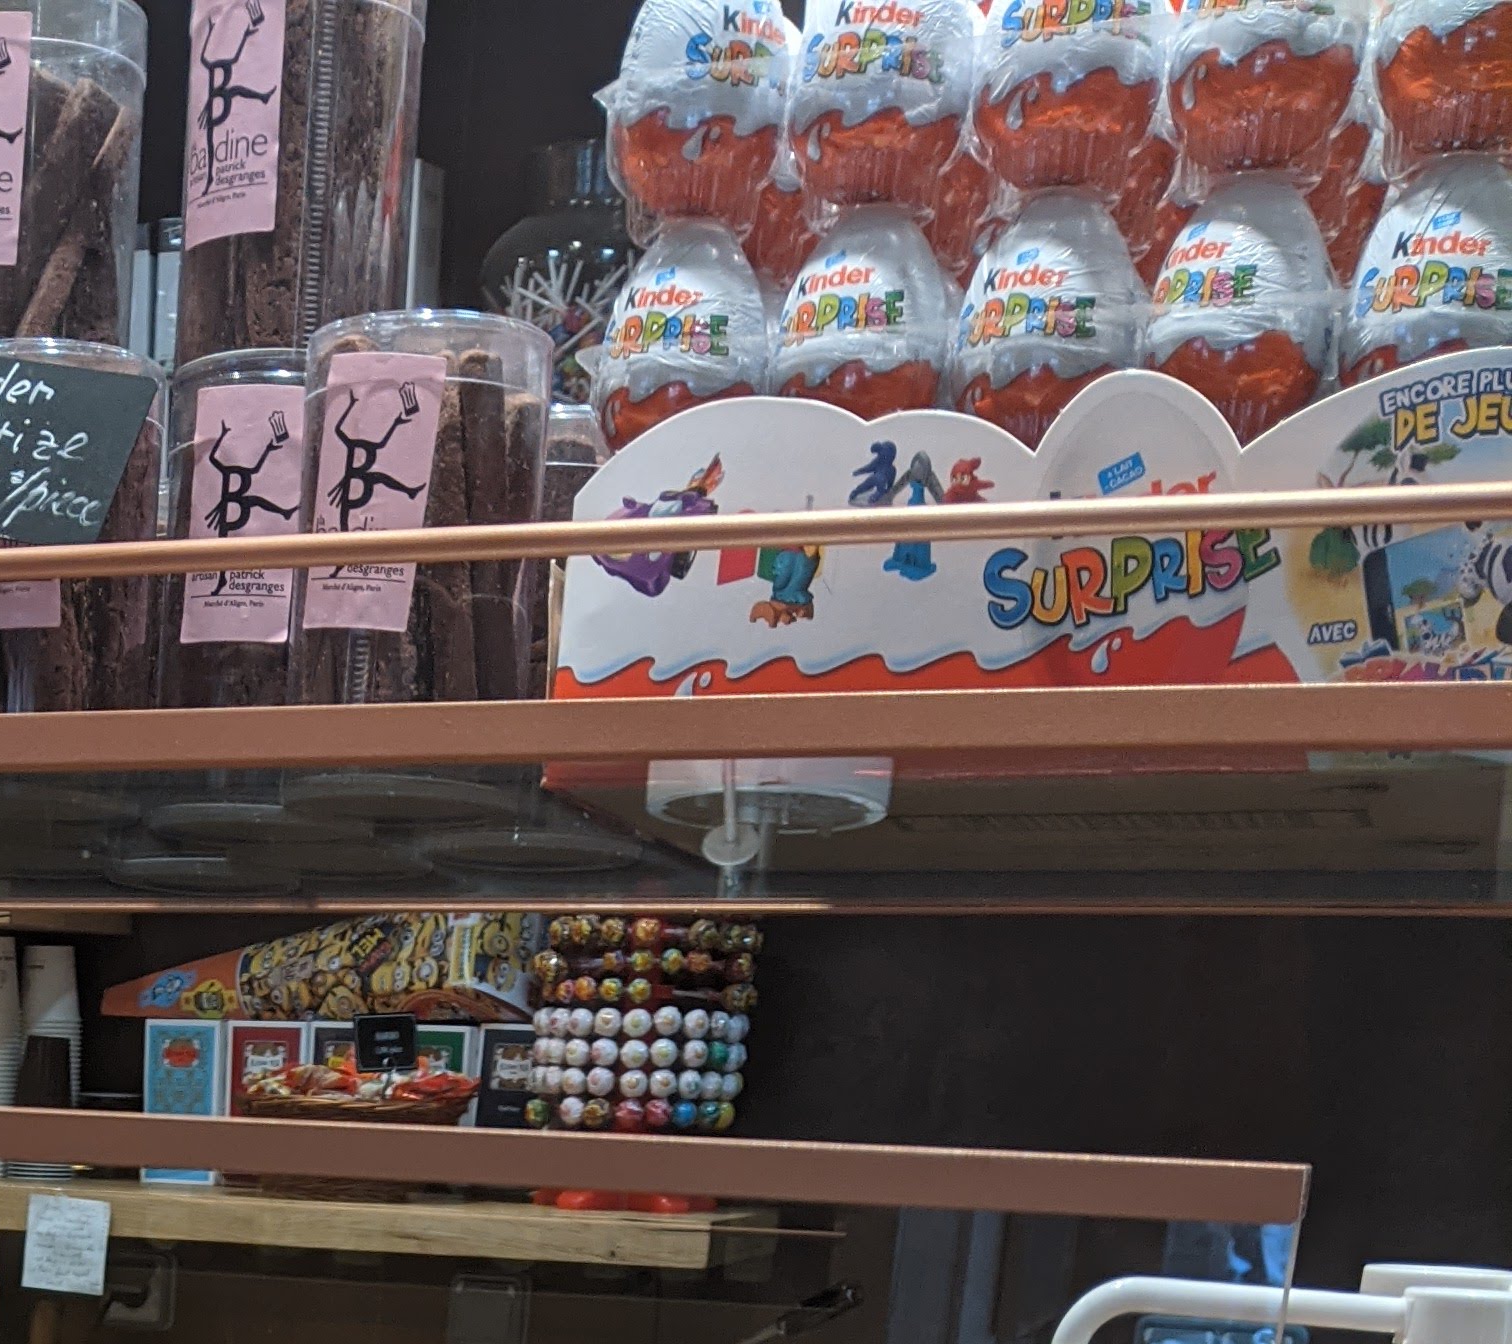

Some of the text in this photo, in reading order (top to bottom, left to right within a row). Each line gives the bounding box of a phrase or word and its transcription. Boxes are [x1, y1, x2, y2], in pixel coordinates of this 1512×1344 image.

[835, 2, 925, 27] Kinder
[1163, 238, 1231, 269] inder
[1392, 231, 1492, 261] Kinder
[798, 264, 876, 297] Kinder
[984, 264, 1069, 293] Kinder
[1152, 264, 1257, 317] RPRISE
[1355, 261, 1512, 318] SURPRISE
[625, 286, 703, 310] Kinder
[1381, 371, 1473, 416] ENCORE
[1393, 401, 1440, 452] DE
[229, 569, 265, 581] patrick
[347, 564, 405, 578] desgranges
[983, 528, 1281, 630] SURPRISE
[229, 580, 285, 594] desgranges
[1308, 620, 1358, 645] AVEC
